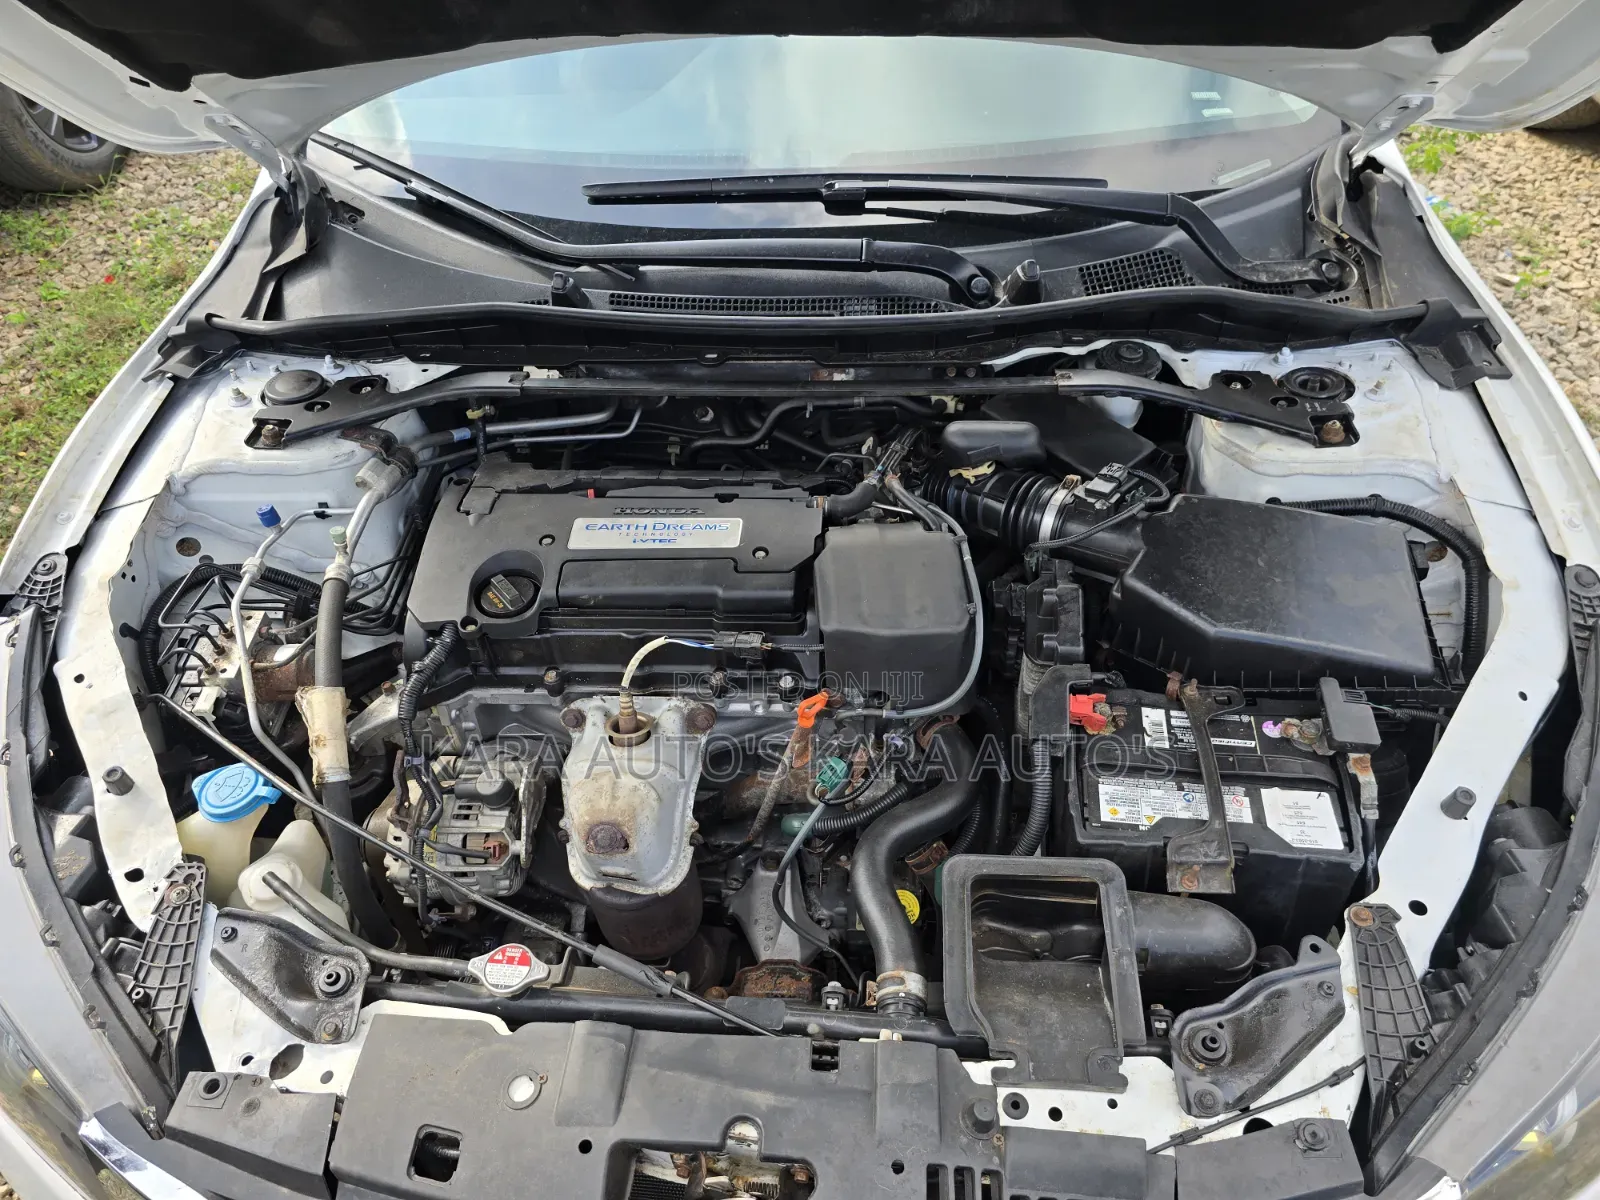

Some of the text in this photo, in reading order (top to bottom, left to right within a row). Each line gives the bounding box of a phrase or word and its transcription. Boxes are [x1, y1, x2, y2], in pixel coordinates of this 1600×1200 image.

[613, 507, 705, 515] HONDA
[585, 522, 730, 531] EARTH DREAMS
